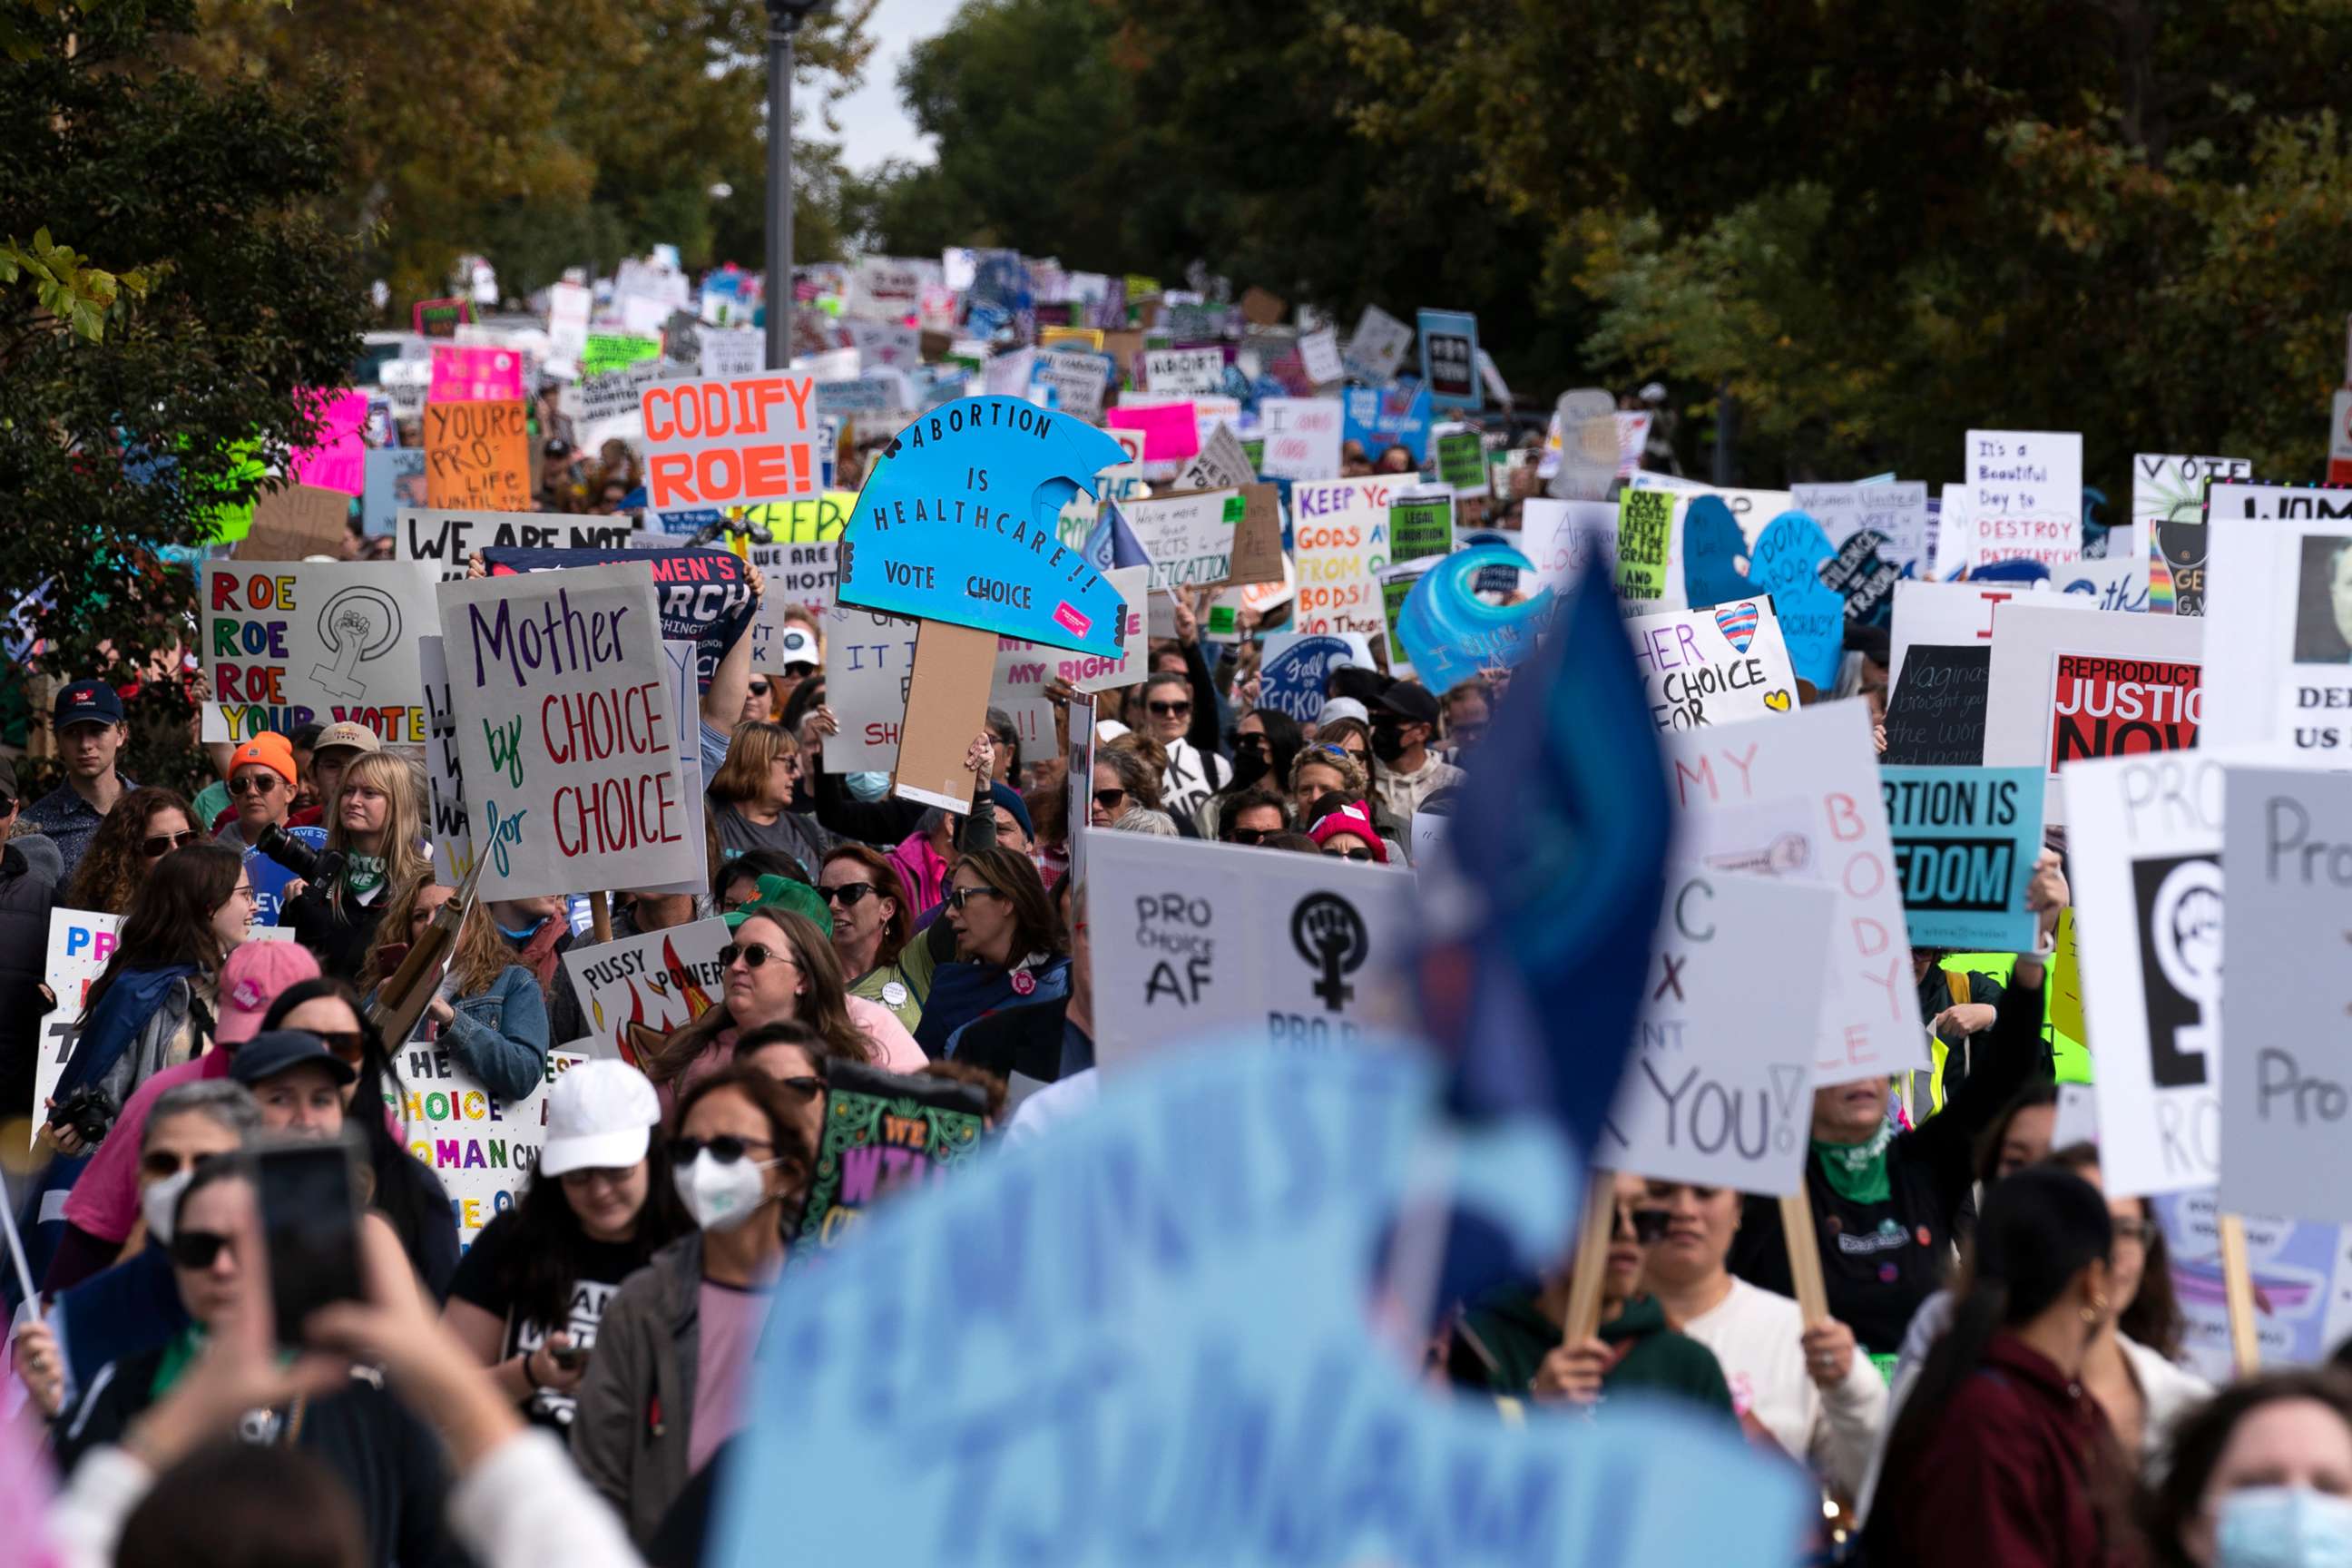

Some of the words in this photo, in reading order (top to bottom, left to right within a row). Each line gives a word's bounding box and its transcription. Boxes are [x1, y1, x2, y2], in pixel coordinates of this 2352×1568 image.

[642, 377, 813, 443] CODIFY
[913, 403, 1053, 448] ABORTION
[651, 444, 811, 507] ROE!
[966, 467, 988, 492] IS
[1979, 465, 2047, 482] Beautiful
[2141, 458, 2248, 480] VOTE
[1299, 486, 1354, 520] KEEP
[1632, 492, 1663, 508] OUR
[408, 518, 474, 567] WE
[874, 499, 1097, 593] HEALTHCARE!!
[1298, 527, 1359, 552] GODS
[1979, 521, 2072, 538] DESTROY
[753, 550, 781, 566] WE
[791, 546, 828, 565] ARE
[1298, 555, 1360, 582] FROM
[211, 572, 297, 612] ROE
[884, 560, 935, 589] VOTE
[966, 575, 1032, 610] CHOICE
[1626, 570, 1652, 584] AND
[214, 617, 289, 658] ROE
[469, 587, 629, 688] Mother
[216, 662, 288, 706] ROE
[1009, 663, 1046, 685] MY
[1059, 652, 1130, 683] RIGHT
[1663, 658, 1767, 703] CHOICE
[331, 705, 425, 743] VOTE
[482, 714, 523, 789] by
[542, 681, 670, 766] CHOICE
[1887, 720, 1926, 744] the
[2295, 728, 2338, 749] US
[1675, 742, 1759, 808] MY
[1987, 779, 2019, 827] IS
[486, 799, 528, 878] for
[553, 770, 682, 858] CHOICE
[1136, 893, 1212, 928] PRO
[1136, 927, 1215, 956] CHOICE
[583, 948, 646, 992] PUSSY
[1145, 957, 1212, 1007] AF
